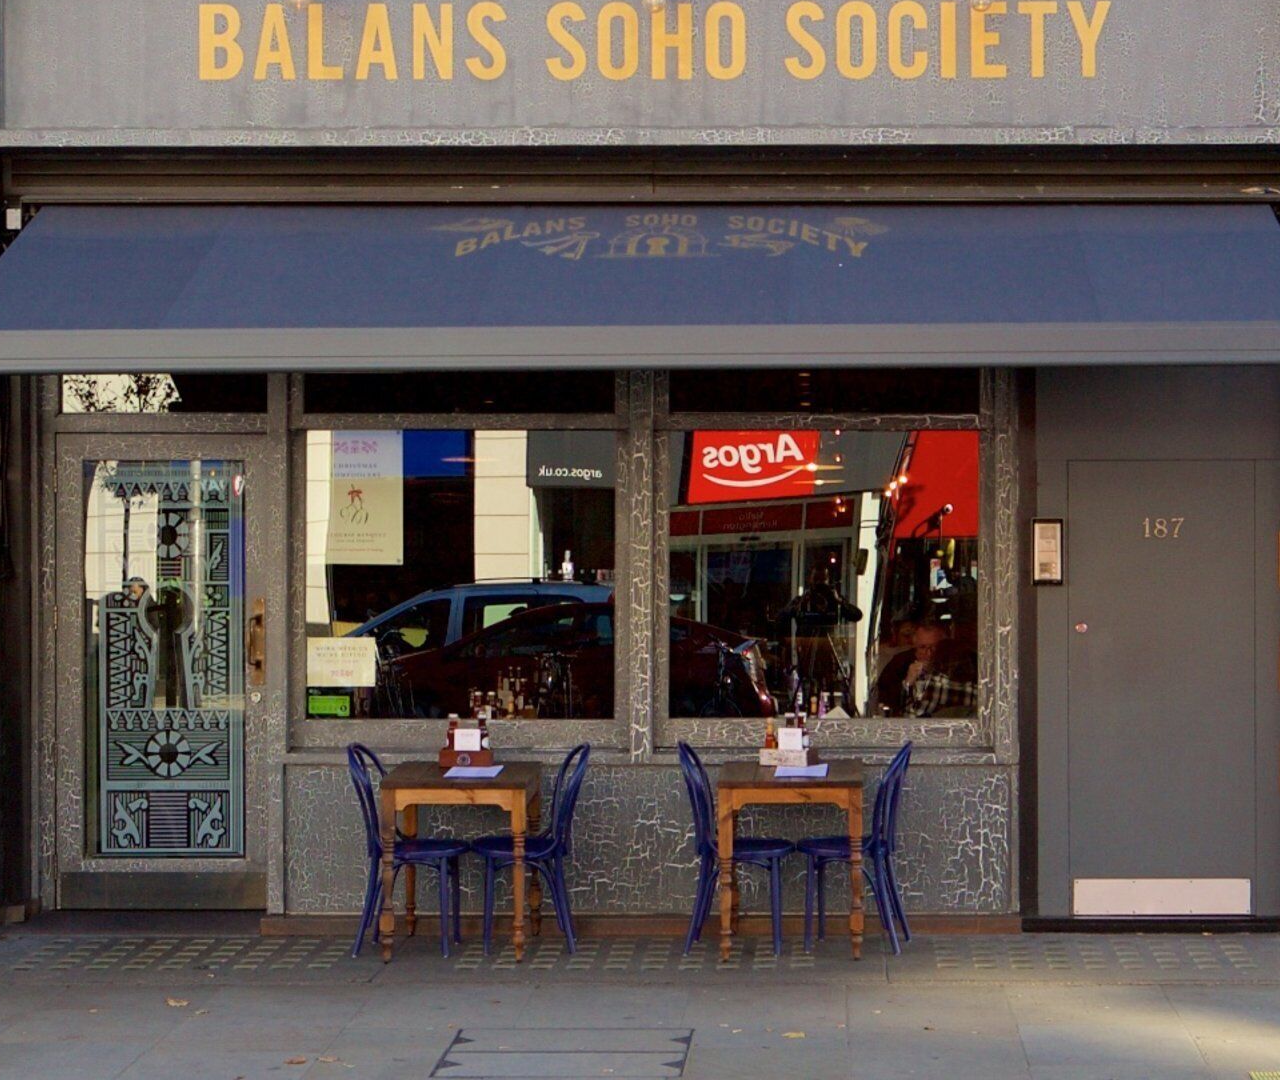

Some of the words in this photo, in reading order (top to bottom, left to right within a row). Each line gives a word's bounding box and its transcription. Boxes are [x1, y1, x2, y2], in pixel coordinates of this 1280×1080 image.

[197, 1, 509, 82] BALANS
[545, 1, 748, 82] SOHO
[785, 0, 1113, 80] SOCIETY
[455, 216, 587, 258] BALANS
[625, 214, 698, 228] SOHO
[728, 215, 869, 258] SOCIETY
[1142, 517, 1185, 538] 187
